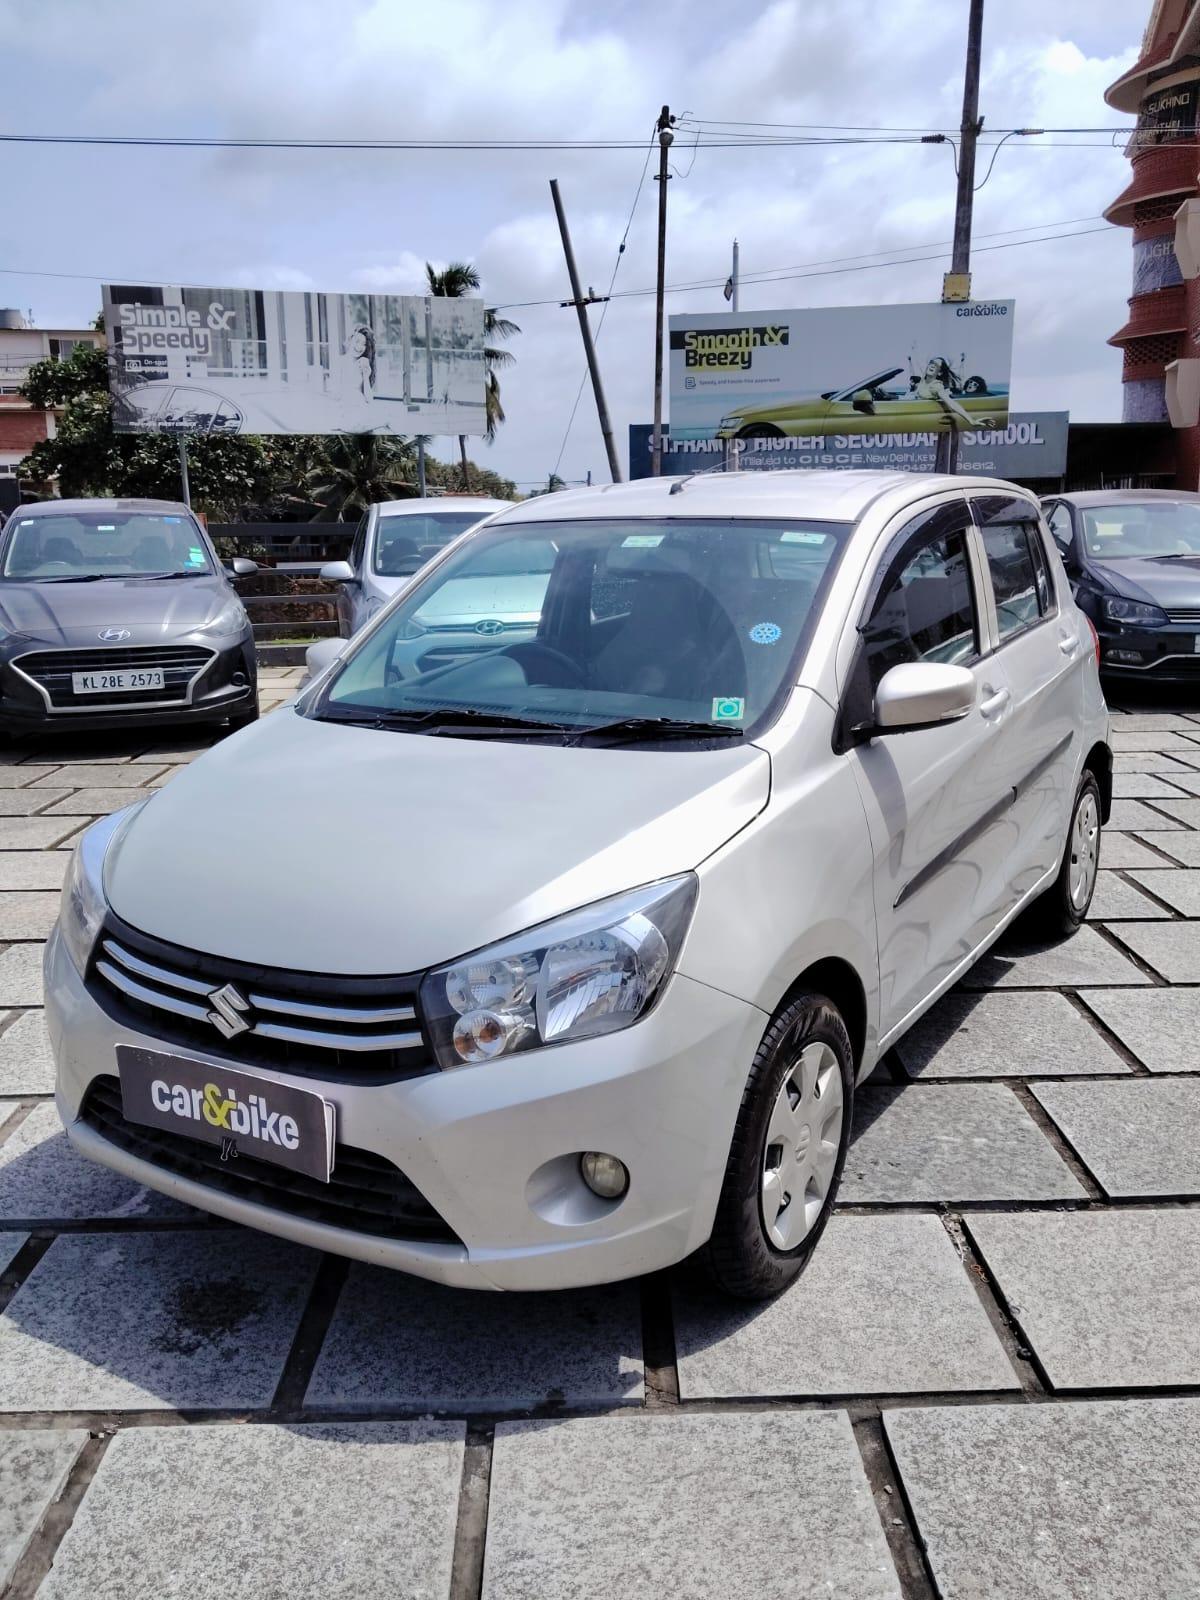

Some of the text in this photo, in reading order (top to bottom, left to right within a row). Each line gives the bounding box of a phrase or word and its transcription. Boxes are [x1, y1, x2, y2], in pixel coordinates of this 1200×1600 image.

[120, 302, 236, 331] Simple &
[956, 304, 1008, 317] car&bike
[122, 327, 209, 355] Speedy
[684, 328, 760, 350] Smooth
[685, 349, 753, 370] Breezy
[962, 423, 1045, 446] SCHOOL
[784, 456, 796, 464] to
[82, 673, 161, 689] KL 28E 2573
[151, 1079, 300, 1150] car&bike
